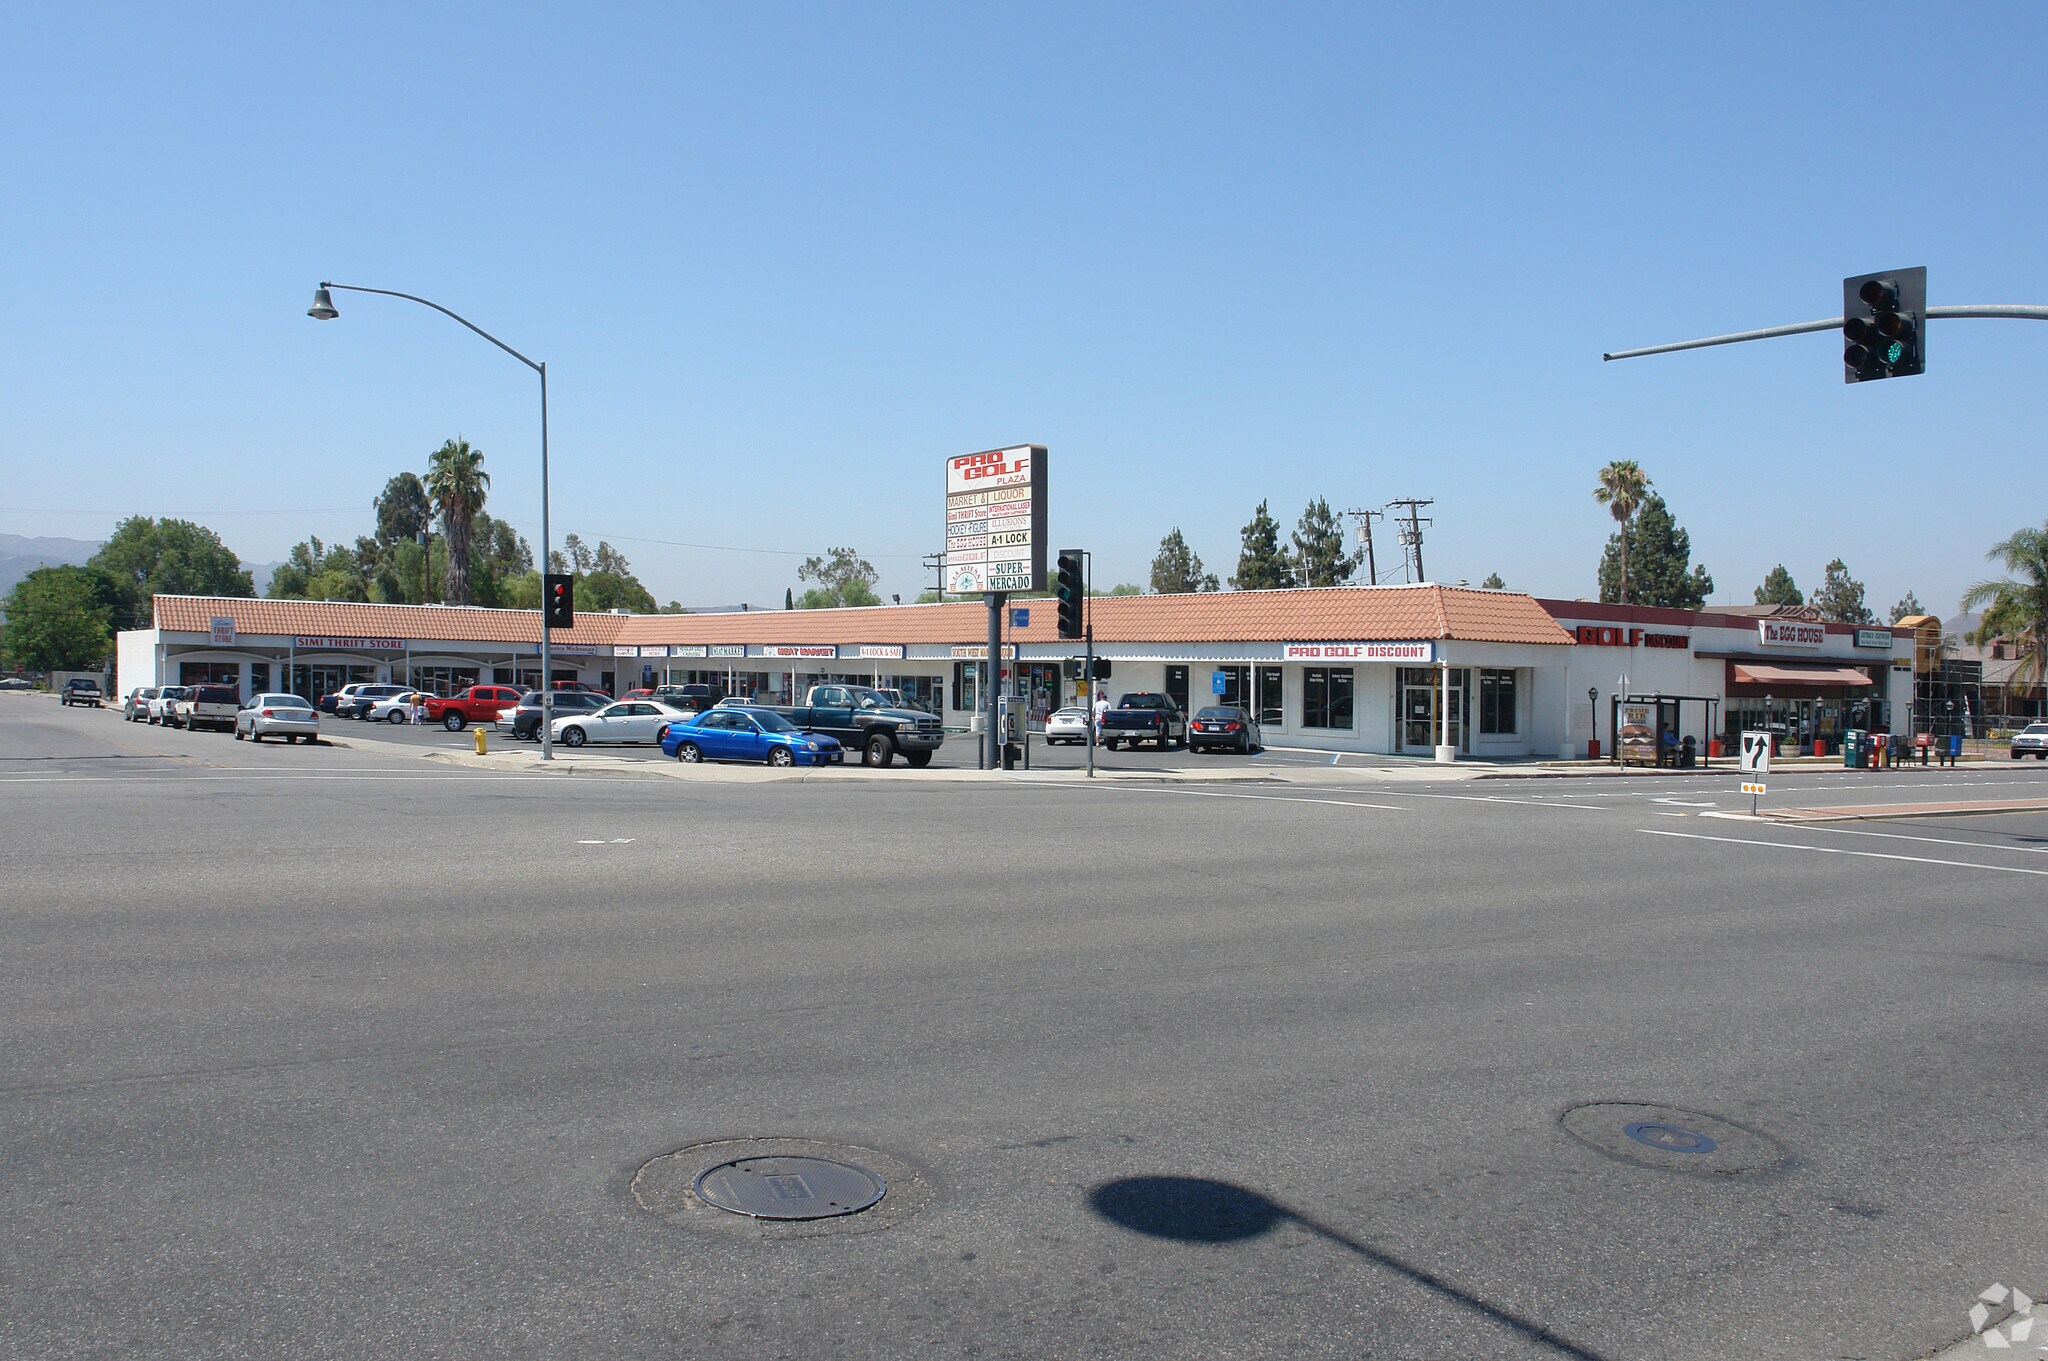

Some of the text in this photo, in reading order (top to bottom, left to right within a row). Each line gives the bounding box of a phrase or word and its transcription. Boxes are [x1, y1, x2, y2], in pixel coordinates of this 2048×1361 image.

[954, 451, 1003, 470] PRO
[964, 458, 1029, 480] GOLF
[996, 474, 1026, 485] PLAZA
[948, 494, 978, 507] MARKET
[993, 488, 1025, 501] LIQUOR
[1018, 501, 1030, 510] LASER
[958, 509, 974, 520] THRIFT
[992, 517, 1027, 528] ILLUSIONS
[957, 537, 967, 548] EGG
[968, 536, 986, 548] HOUSE
[1005, 532, 1028, 544] LOCK
[993, 549, 1025, 559] DISCOUNT
[995, 562, 1023, 575] SUPER
[990, 576, 1030, 590] MERCADO
[213, 626, 233, 635] THRIFT
[1765, 625, 1824, 644] The EGG HOUSE
[214, 635, 233, 643] STORE
[298, 637, 403, 649] SIMI THRIFT STORE
[1577, 625, 1690, 649] GOLF DISCOUNT
[777, 647, 834, 656] MEAT MARKET
[870, 648, 884, 657] LOCK
[889, 648, 902, 657] SAFE
[1288, 646, 1425, 657] PRO GOLF DISCOUNT
